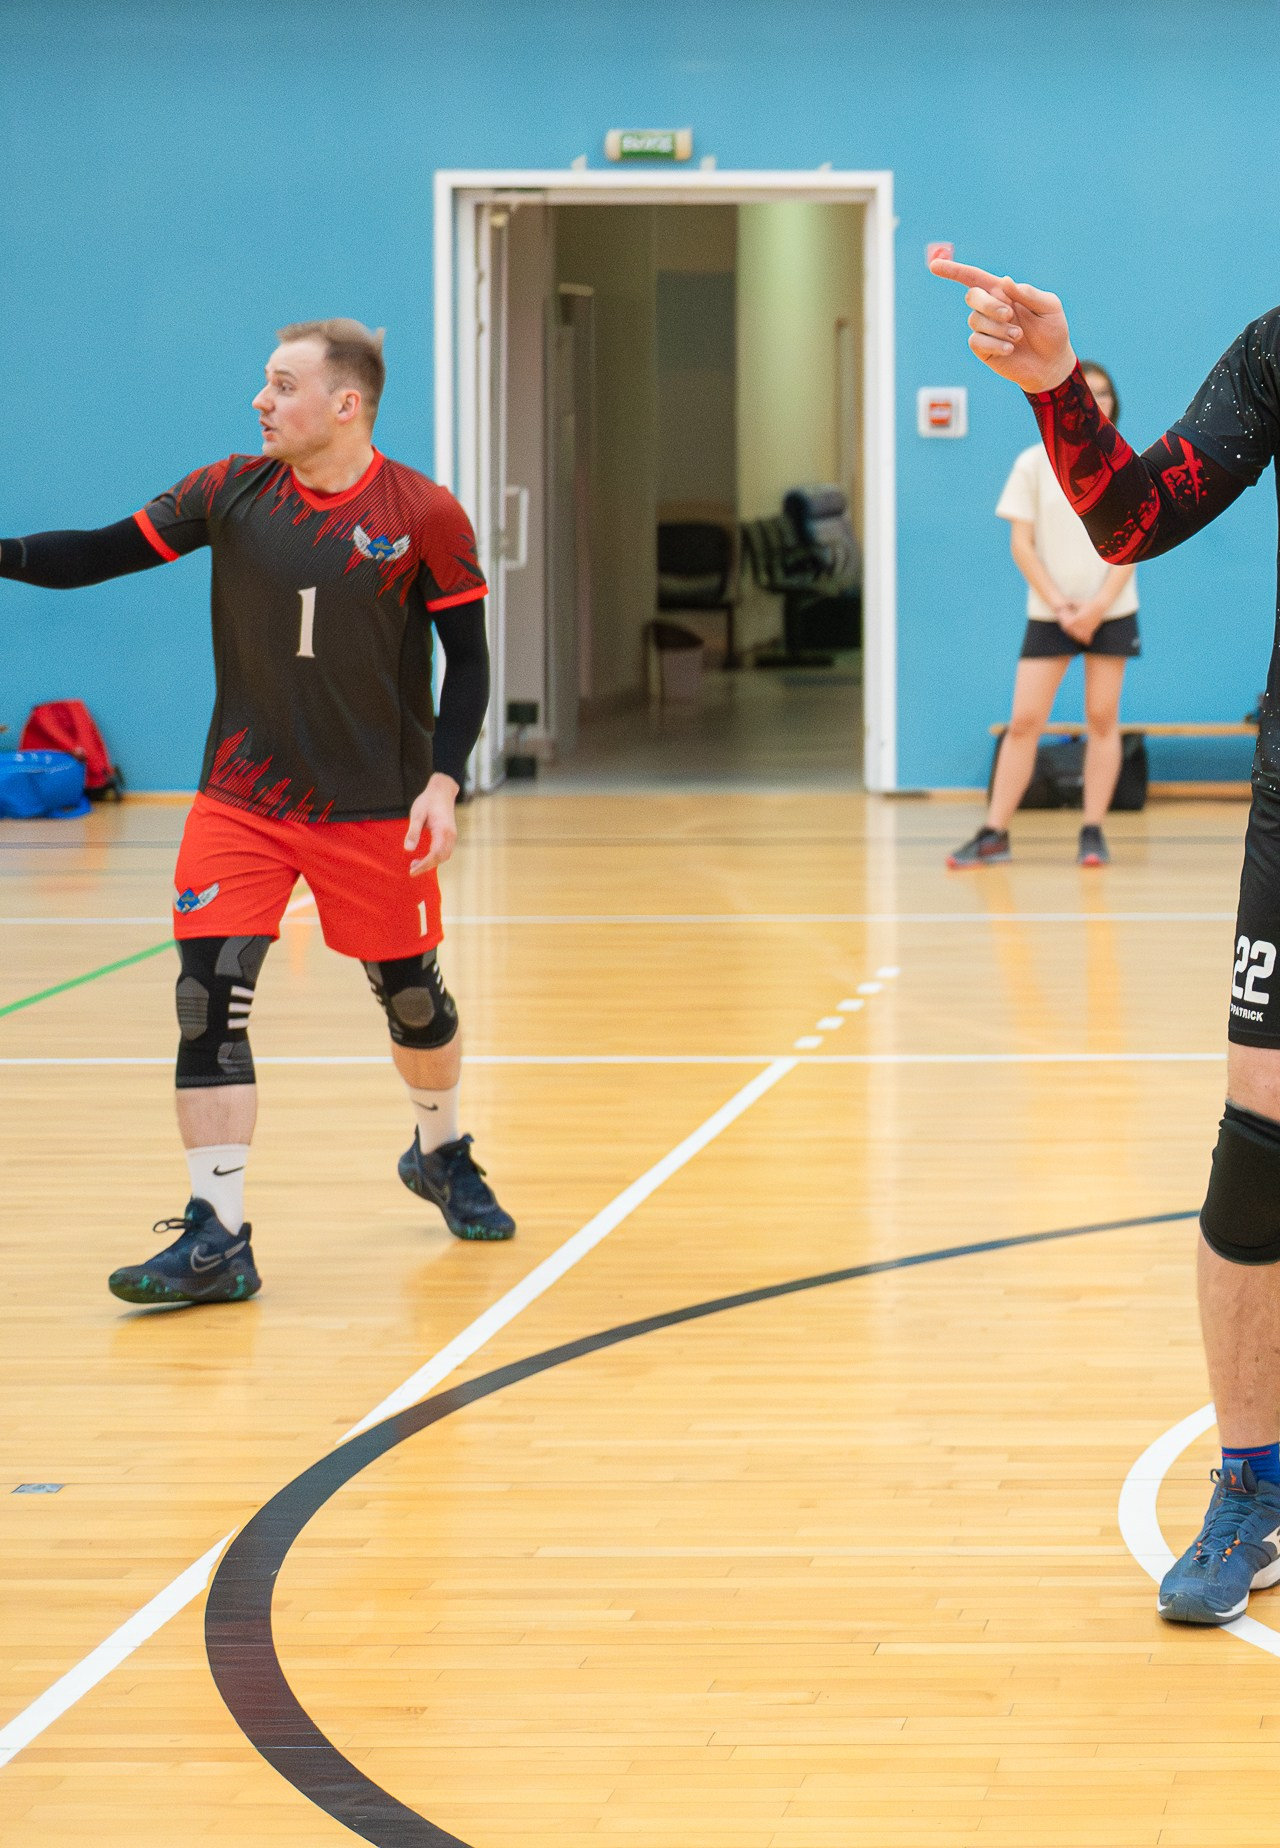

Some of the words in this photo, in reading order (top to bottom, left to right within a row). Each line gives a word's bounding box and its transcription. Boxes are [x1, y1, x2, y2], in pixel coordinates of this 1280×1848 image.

[296, 586, 317, 658] 1
[417, 900, 428, 937] 1
[1232, 935, 1277, 1005] 22
